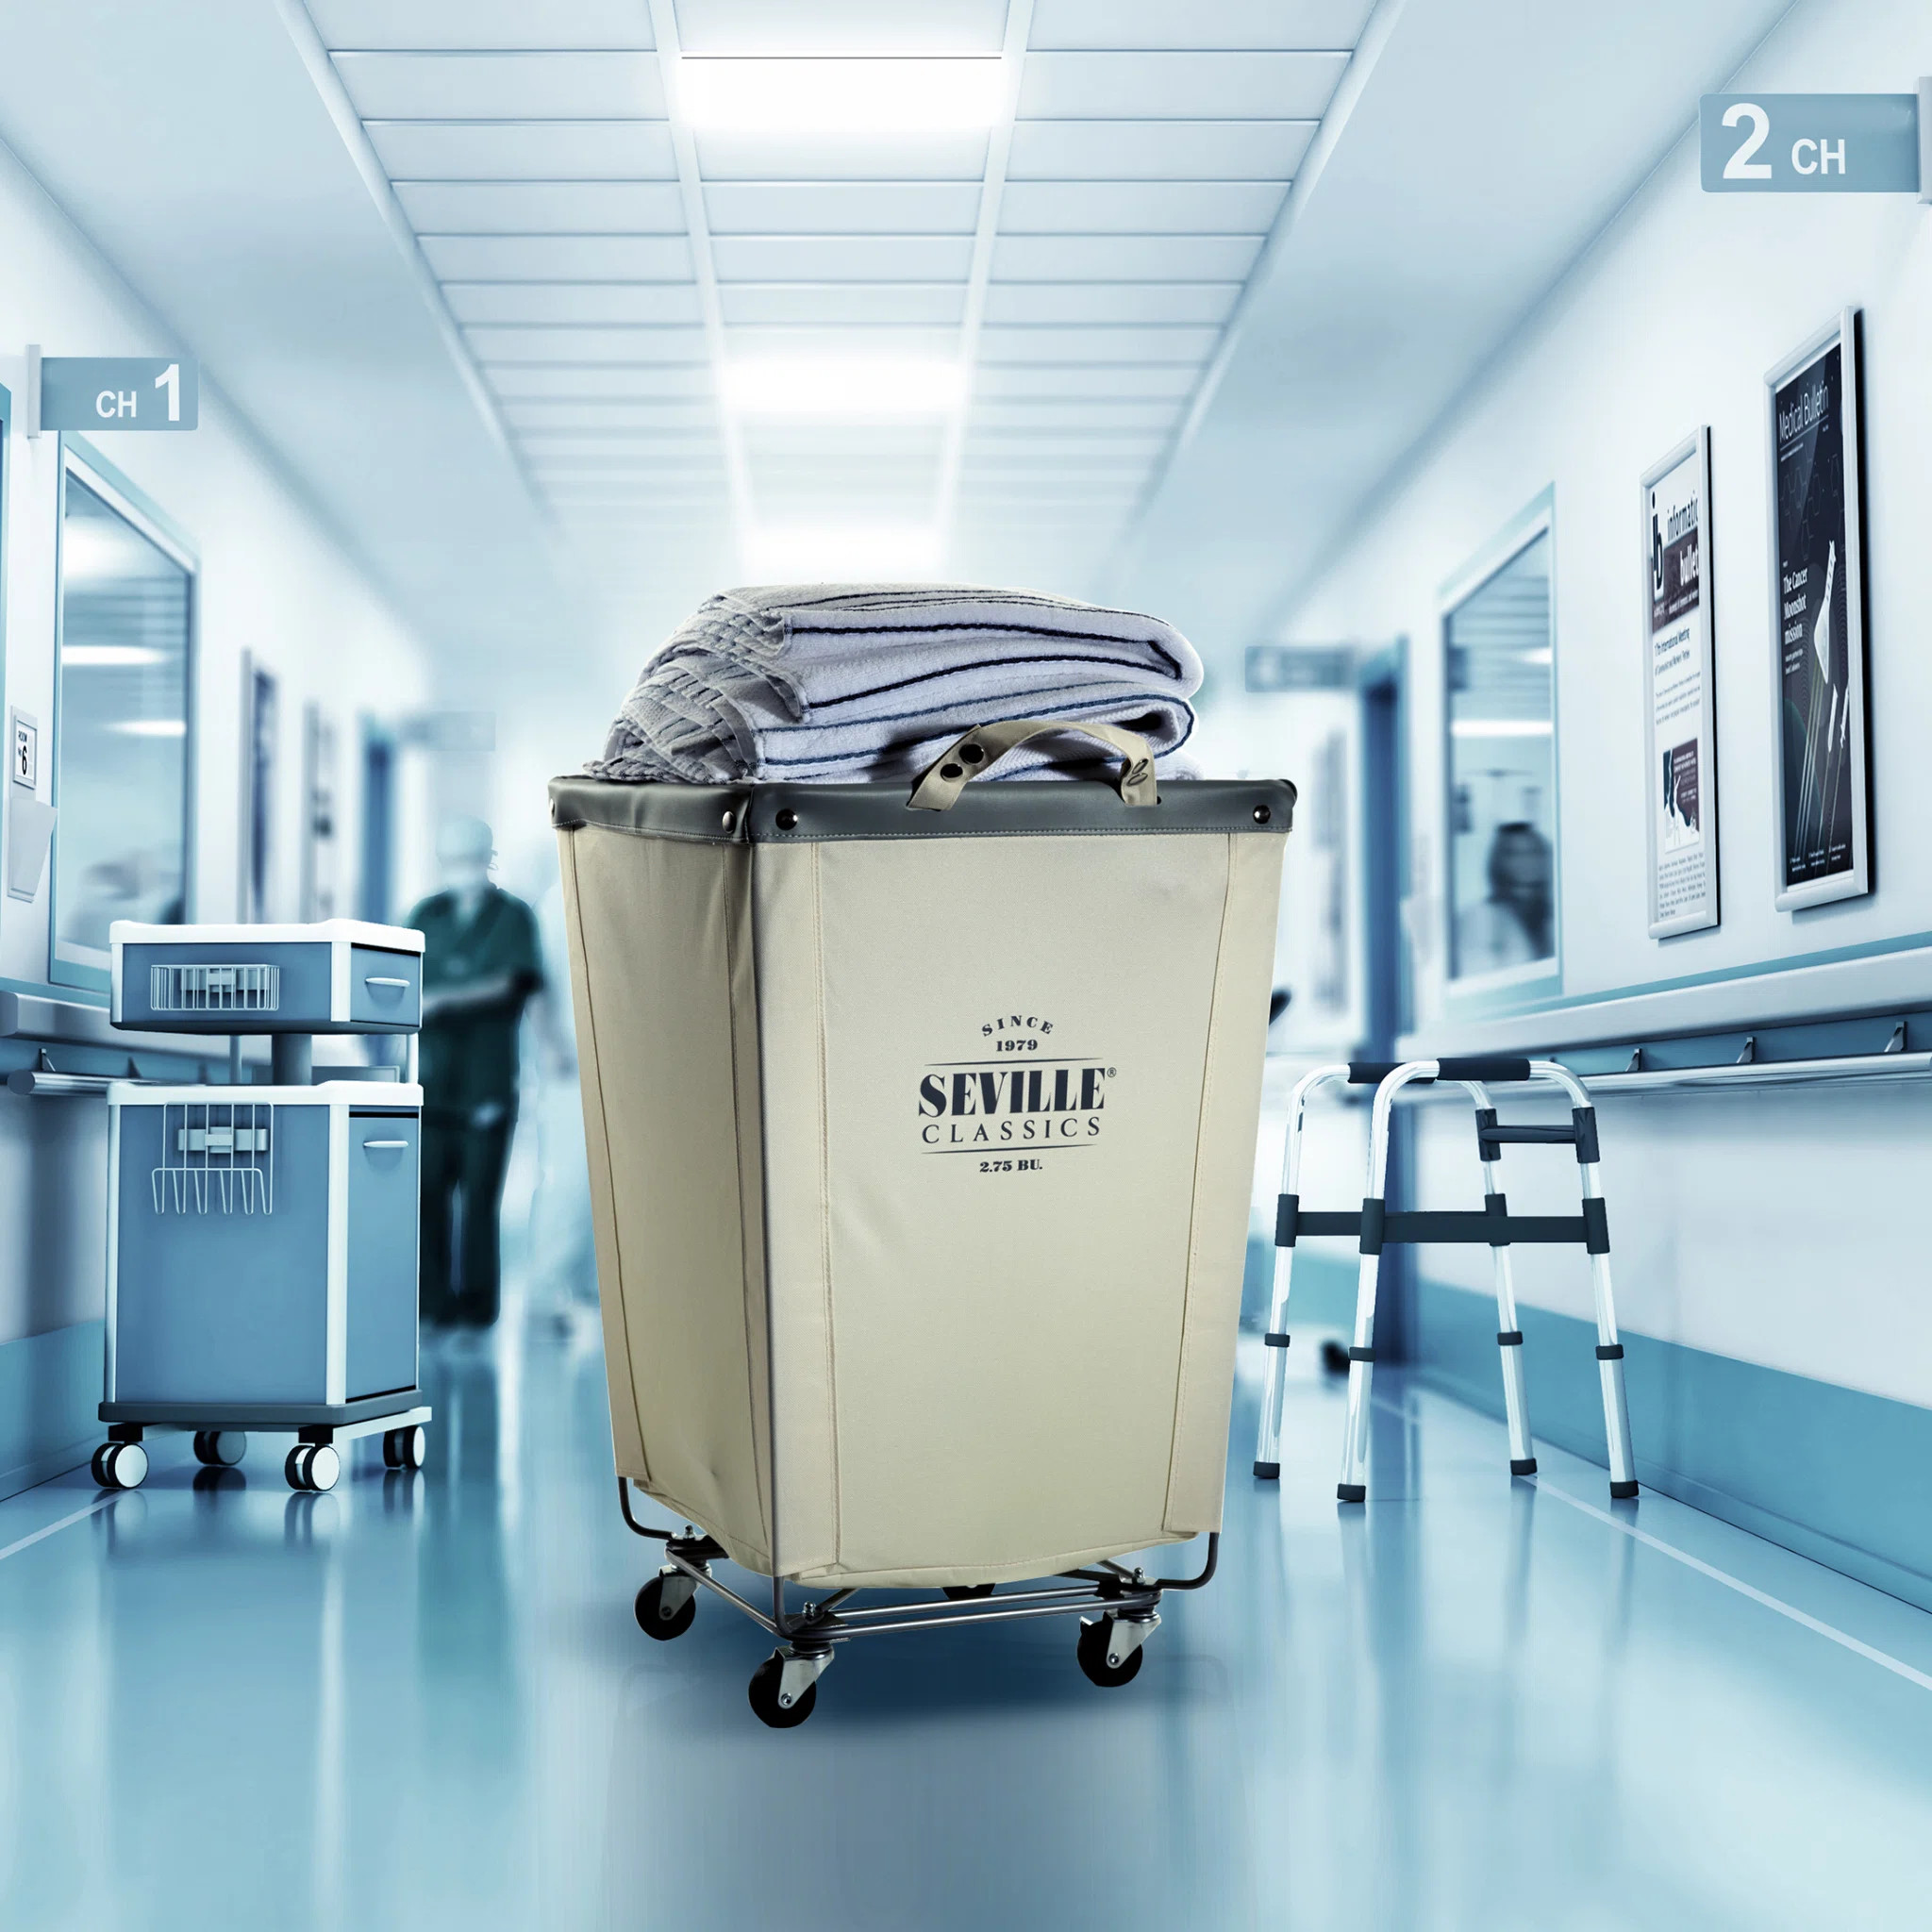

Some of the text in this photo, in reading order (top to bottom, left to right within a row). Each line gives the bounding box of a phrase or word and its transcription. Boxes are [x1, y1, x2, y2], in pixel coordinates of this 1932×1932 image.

[1722, 102, 1846, 179] 2 CH
[95, 363, 180, 422] CH 1
[1779, 380, 1828, 442] Medical Bulletin
[22, 745, 27, 775] 6
[981, 1015, 1054, 1037] SINCE
[995, 1039, 1039, 1052] 1979
[922, 1116, 1100, 1144] CLASSICS
[979, 1158, 1043, 1173] 2.75 BU.
